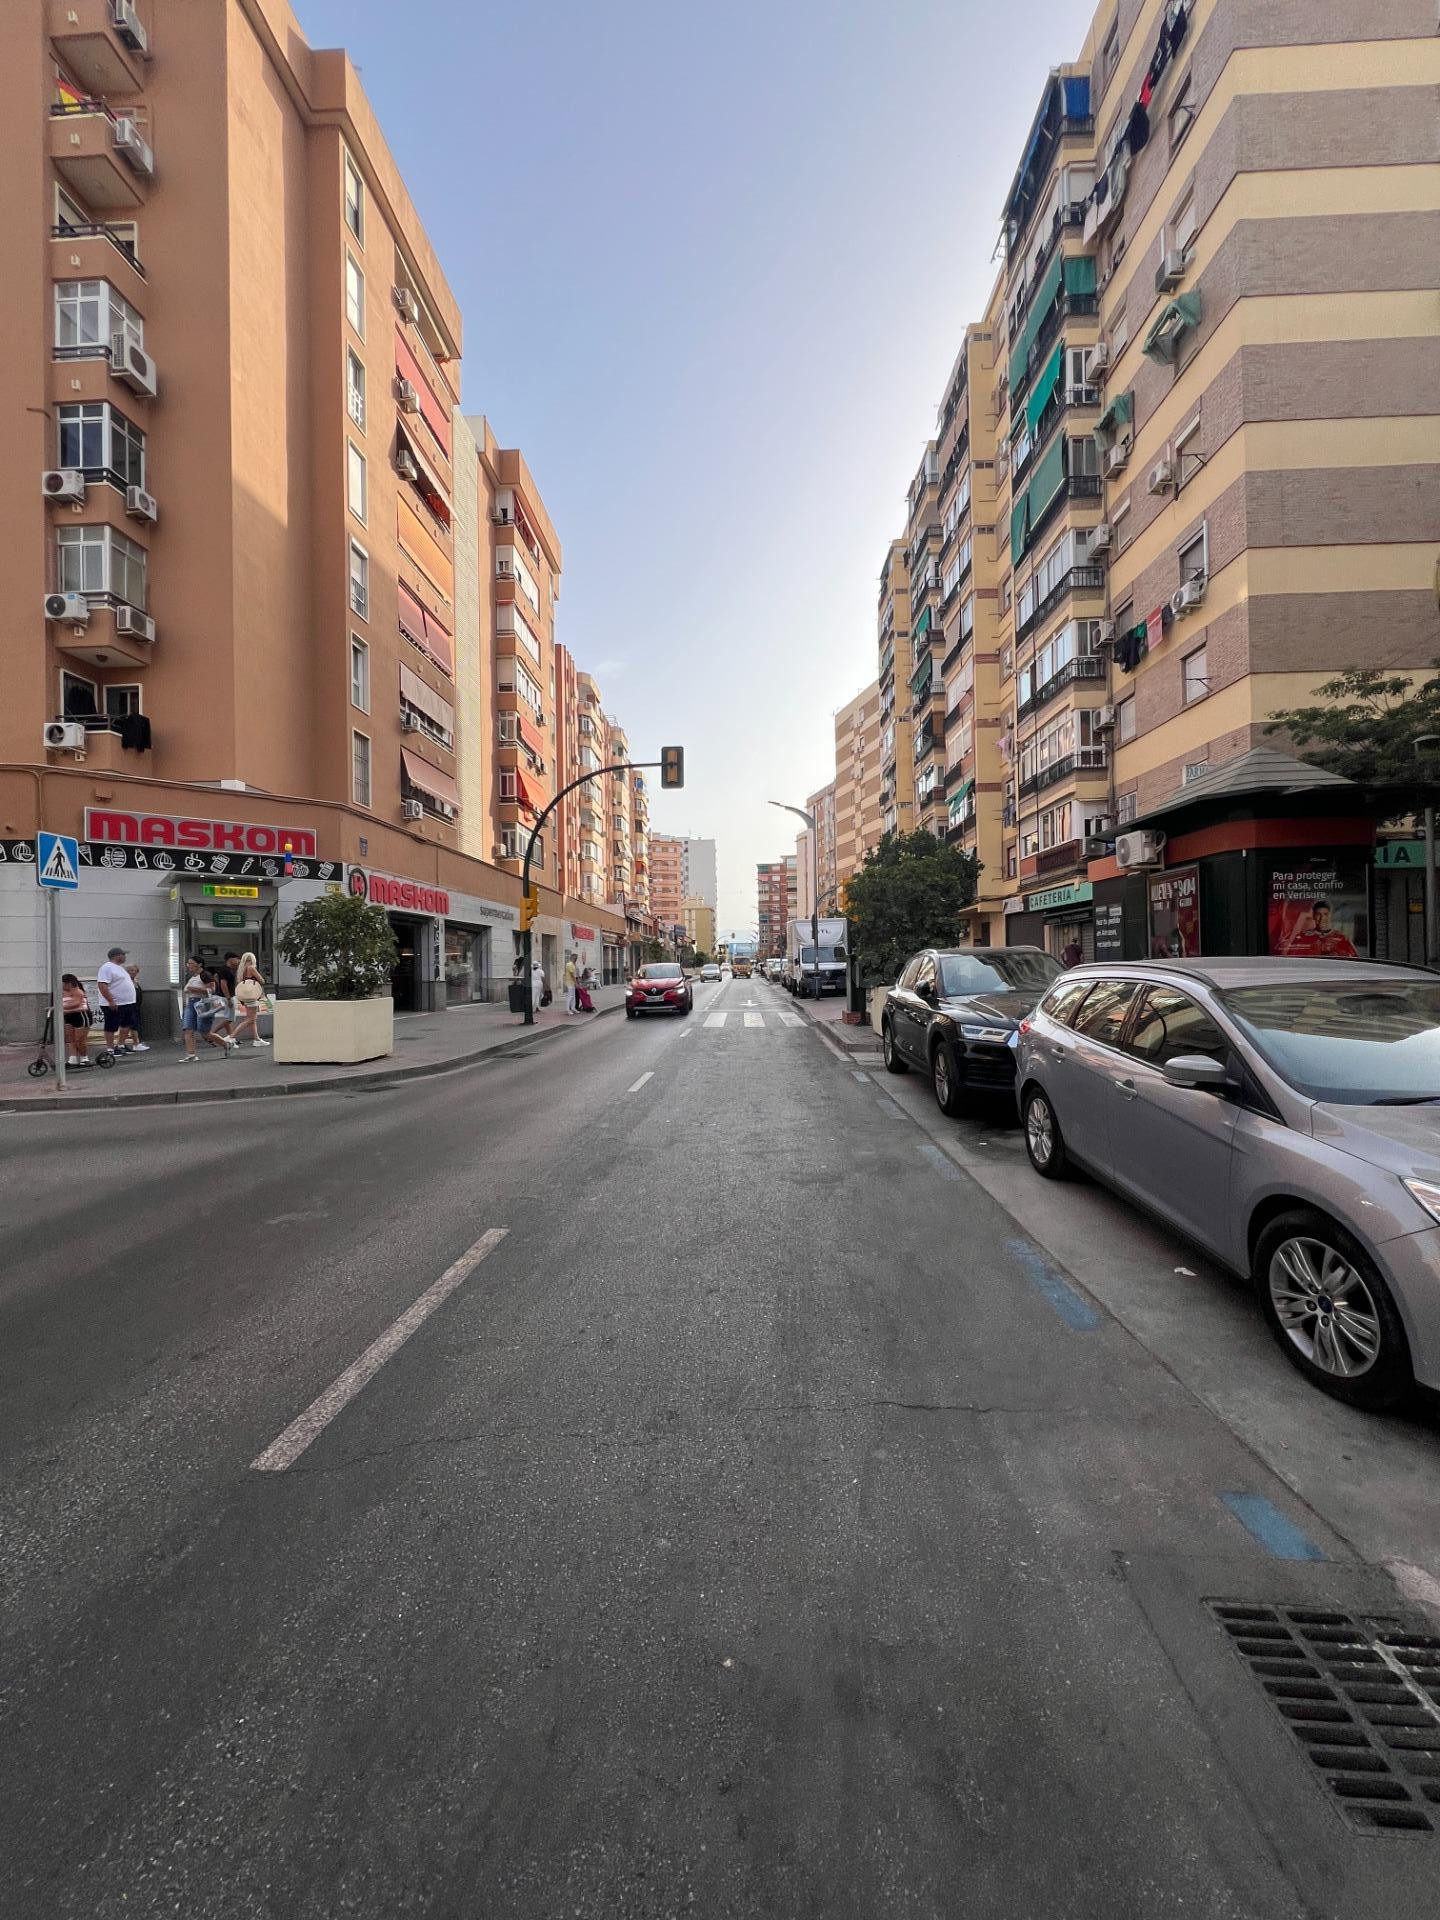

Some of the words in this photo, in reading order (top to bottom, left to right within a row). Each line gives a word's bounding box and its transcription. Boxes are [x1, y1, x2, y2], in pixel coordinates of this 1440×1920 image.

[89, 811, 316, 855] MASKOM
[1272, 871, 1293, 880] Para
[1296, 871, 1337, 882] proteger
[219, 886, 254, 896] ONCE
[1272, 880, 1286, 891] mi
[369, 874, 450, 915] MASKOM
[1272, 892, 1286, 900] en
